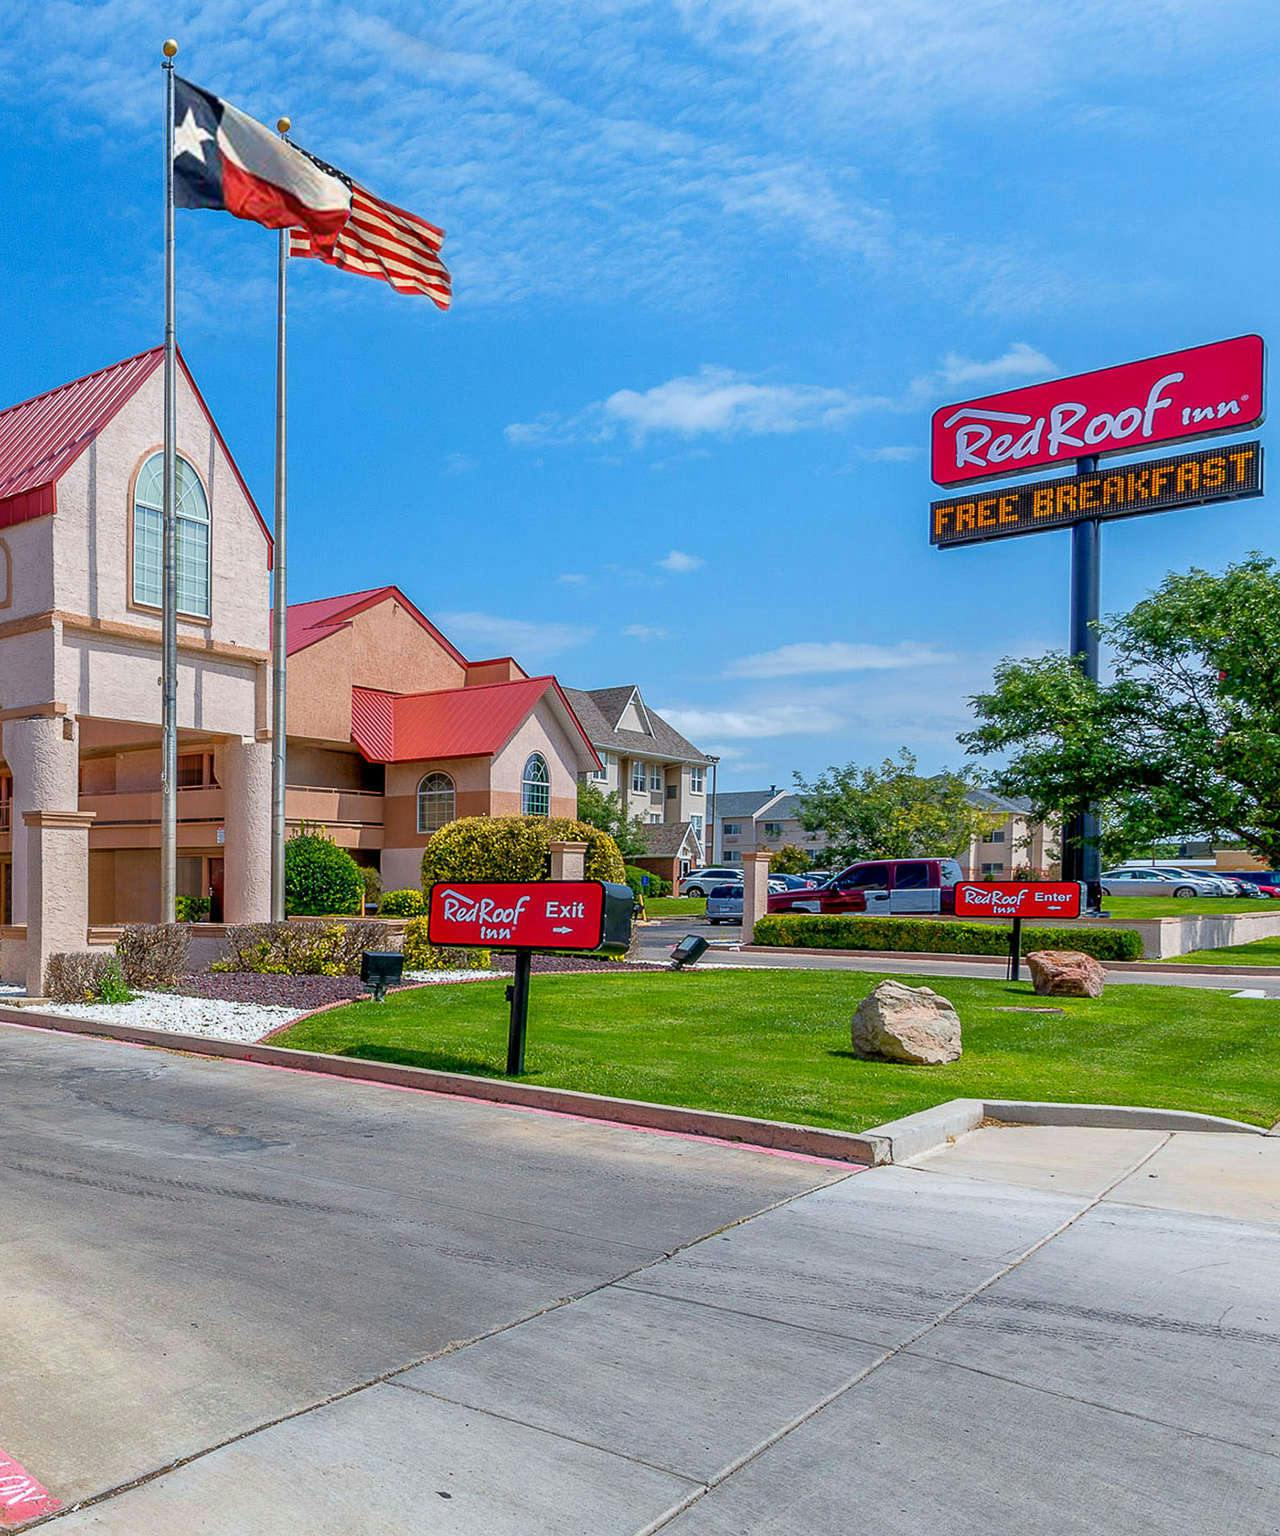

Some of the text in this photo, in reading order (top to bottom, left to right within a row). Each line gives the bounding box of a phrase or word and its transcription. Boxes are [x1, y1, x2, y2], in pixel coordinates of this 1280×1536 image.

[934, 450, 1254, 535] FREE BREAKFAST
[1034, 891, 1073, 903] Enter
[545, 901, 585, 919] Exit
